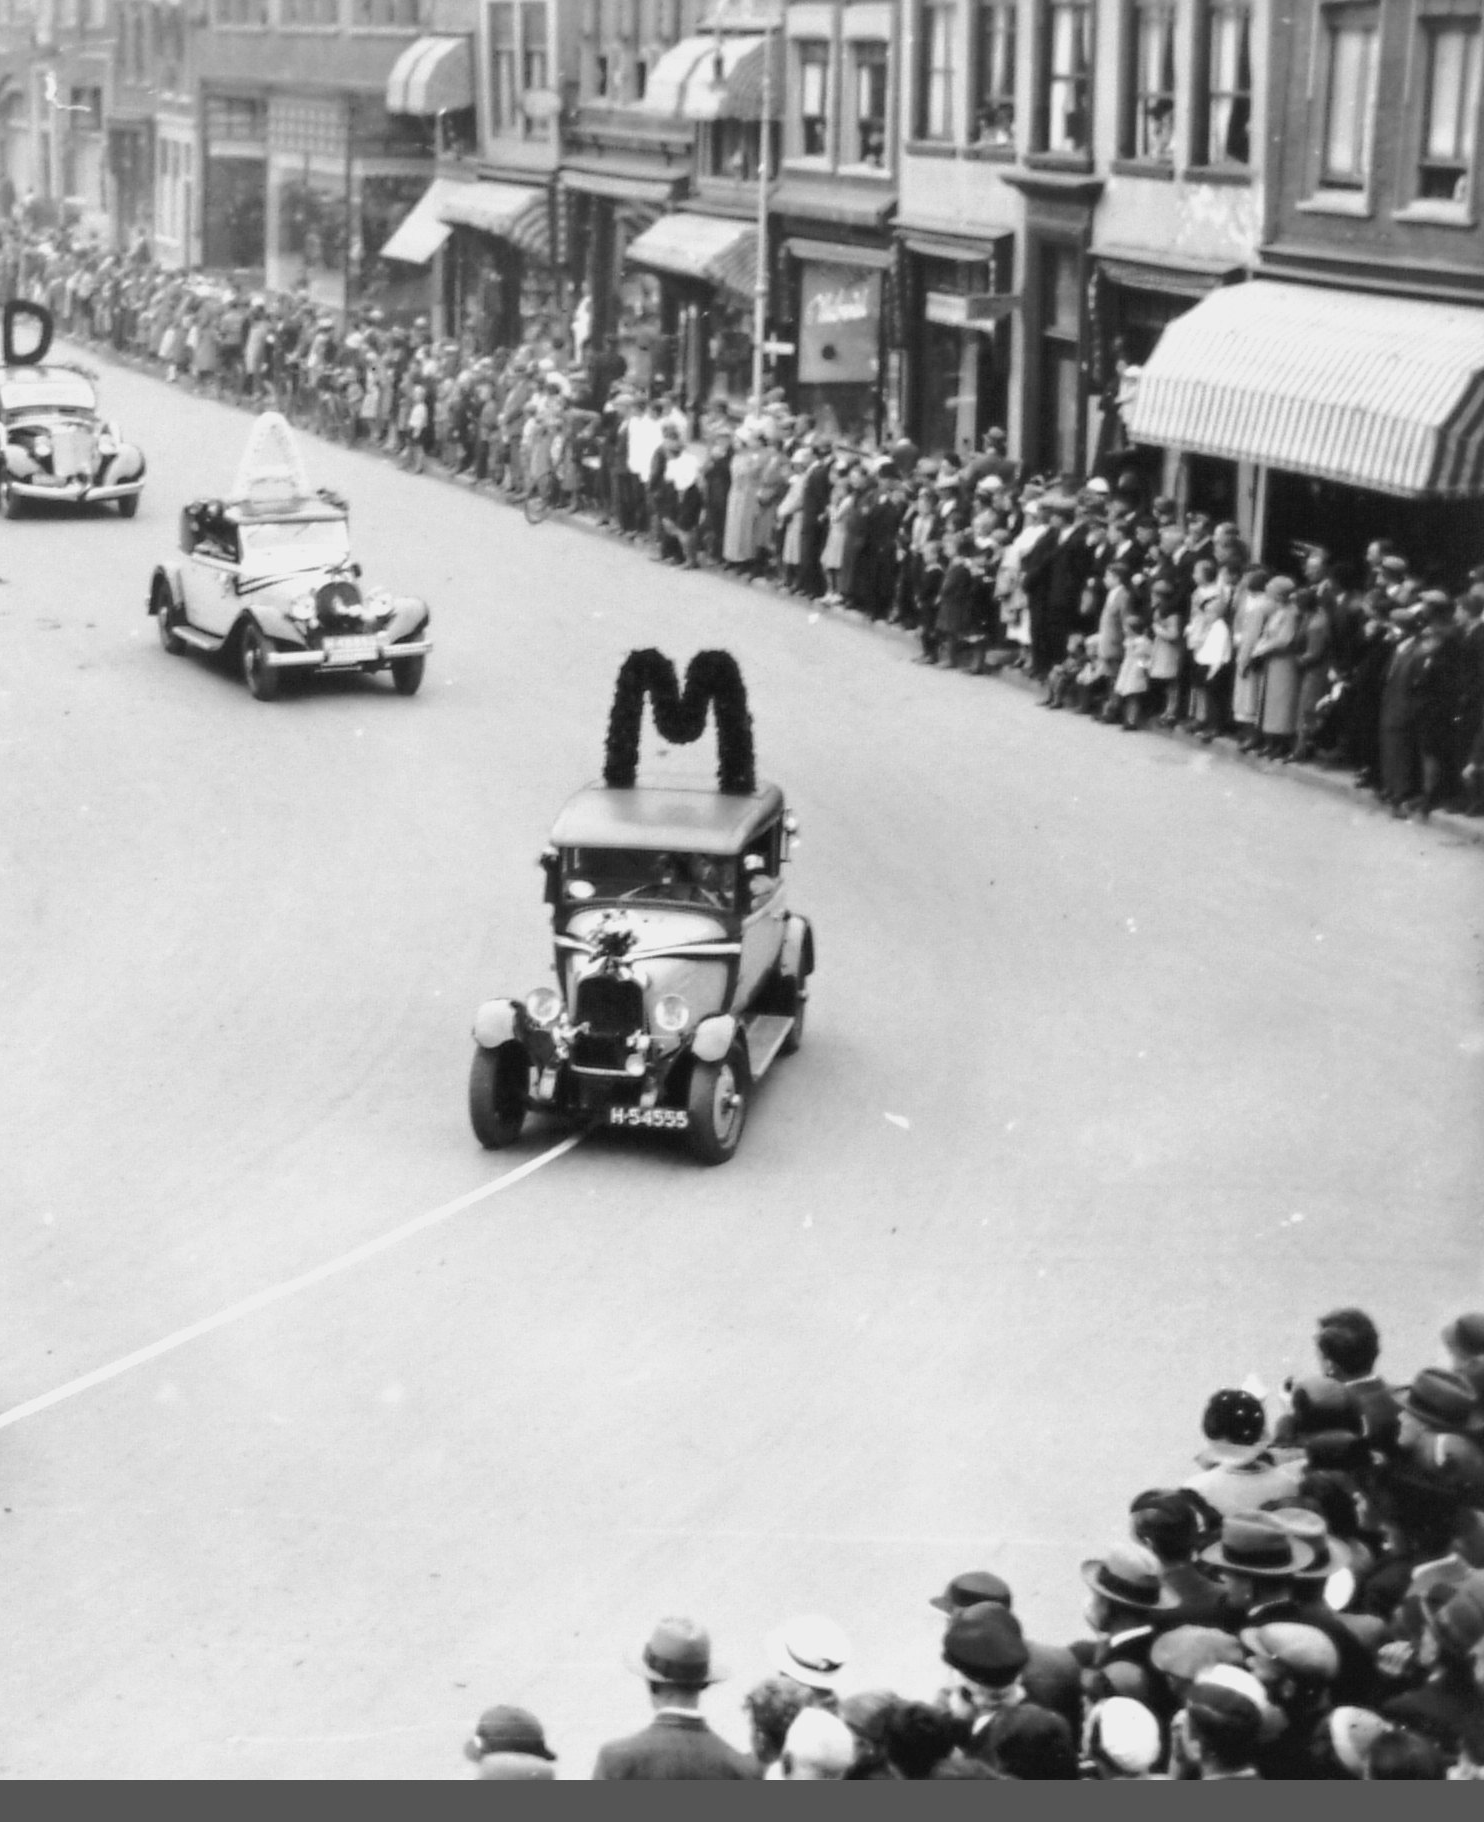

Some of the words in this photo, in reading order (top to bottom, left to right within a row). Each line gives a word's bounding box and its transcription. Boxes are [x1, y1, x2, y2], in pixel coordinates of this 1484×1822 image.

[3, 299, 54, 366] D
[230, 410, 311, 501] A
[603, 648, 756, 795] M
[609, 1106, 689, 1129] H-54555
